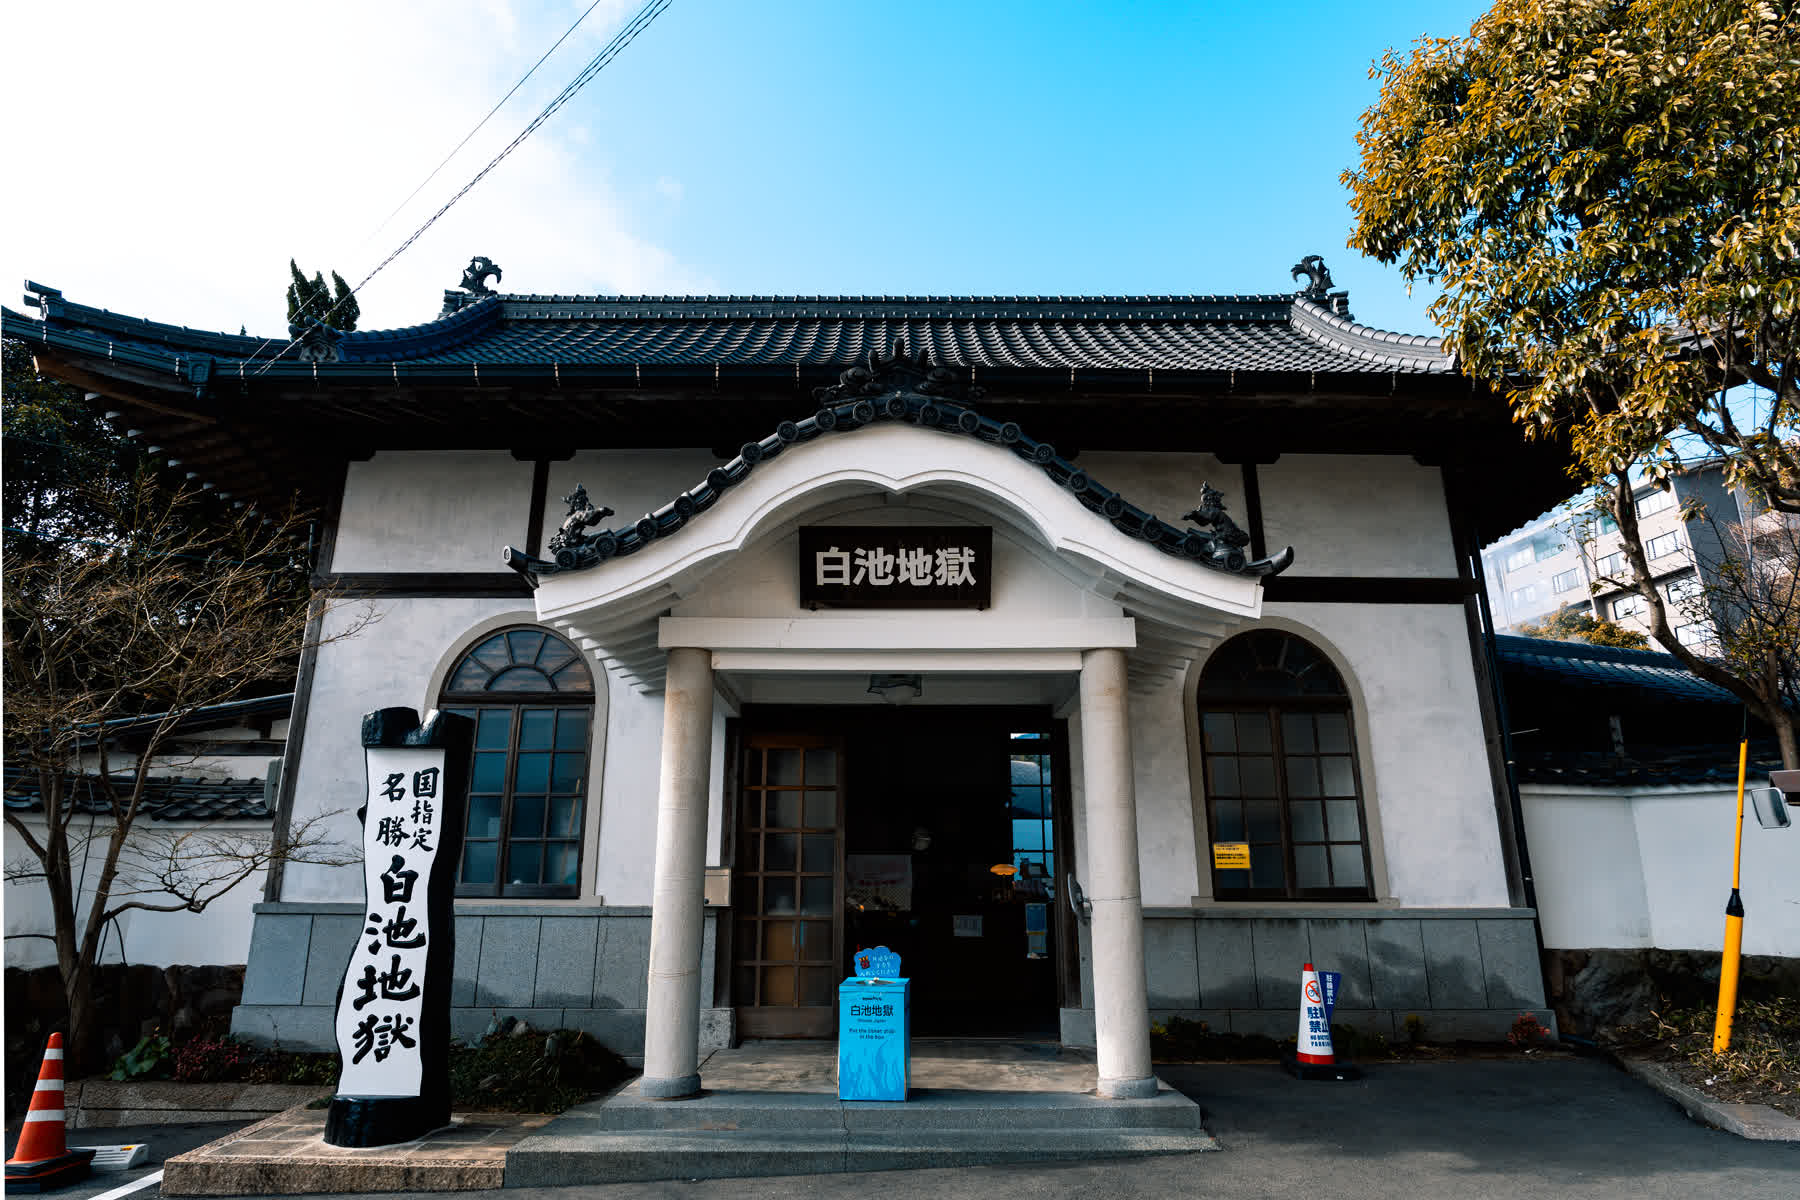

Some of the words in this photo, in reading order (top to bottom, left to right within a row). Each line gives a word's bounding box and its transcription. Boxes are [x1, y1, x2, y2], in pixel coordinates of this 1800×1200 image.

[815, 546, 977, 586] 白池地獄
[375, 772, 411, 847] 名勝
[408, 766, 440, 853] 国指定
[352, 854, 427, 1065] 白池地獄
[850, 1004, 894, 1017] 白池地獄
